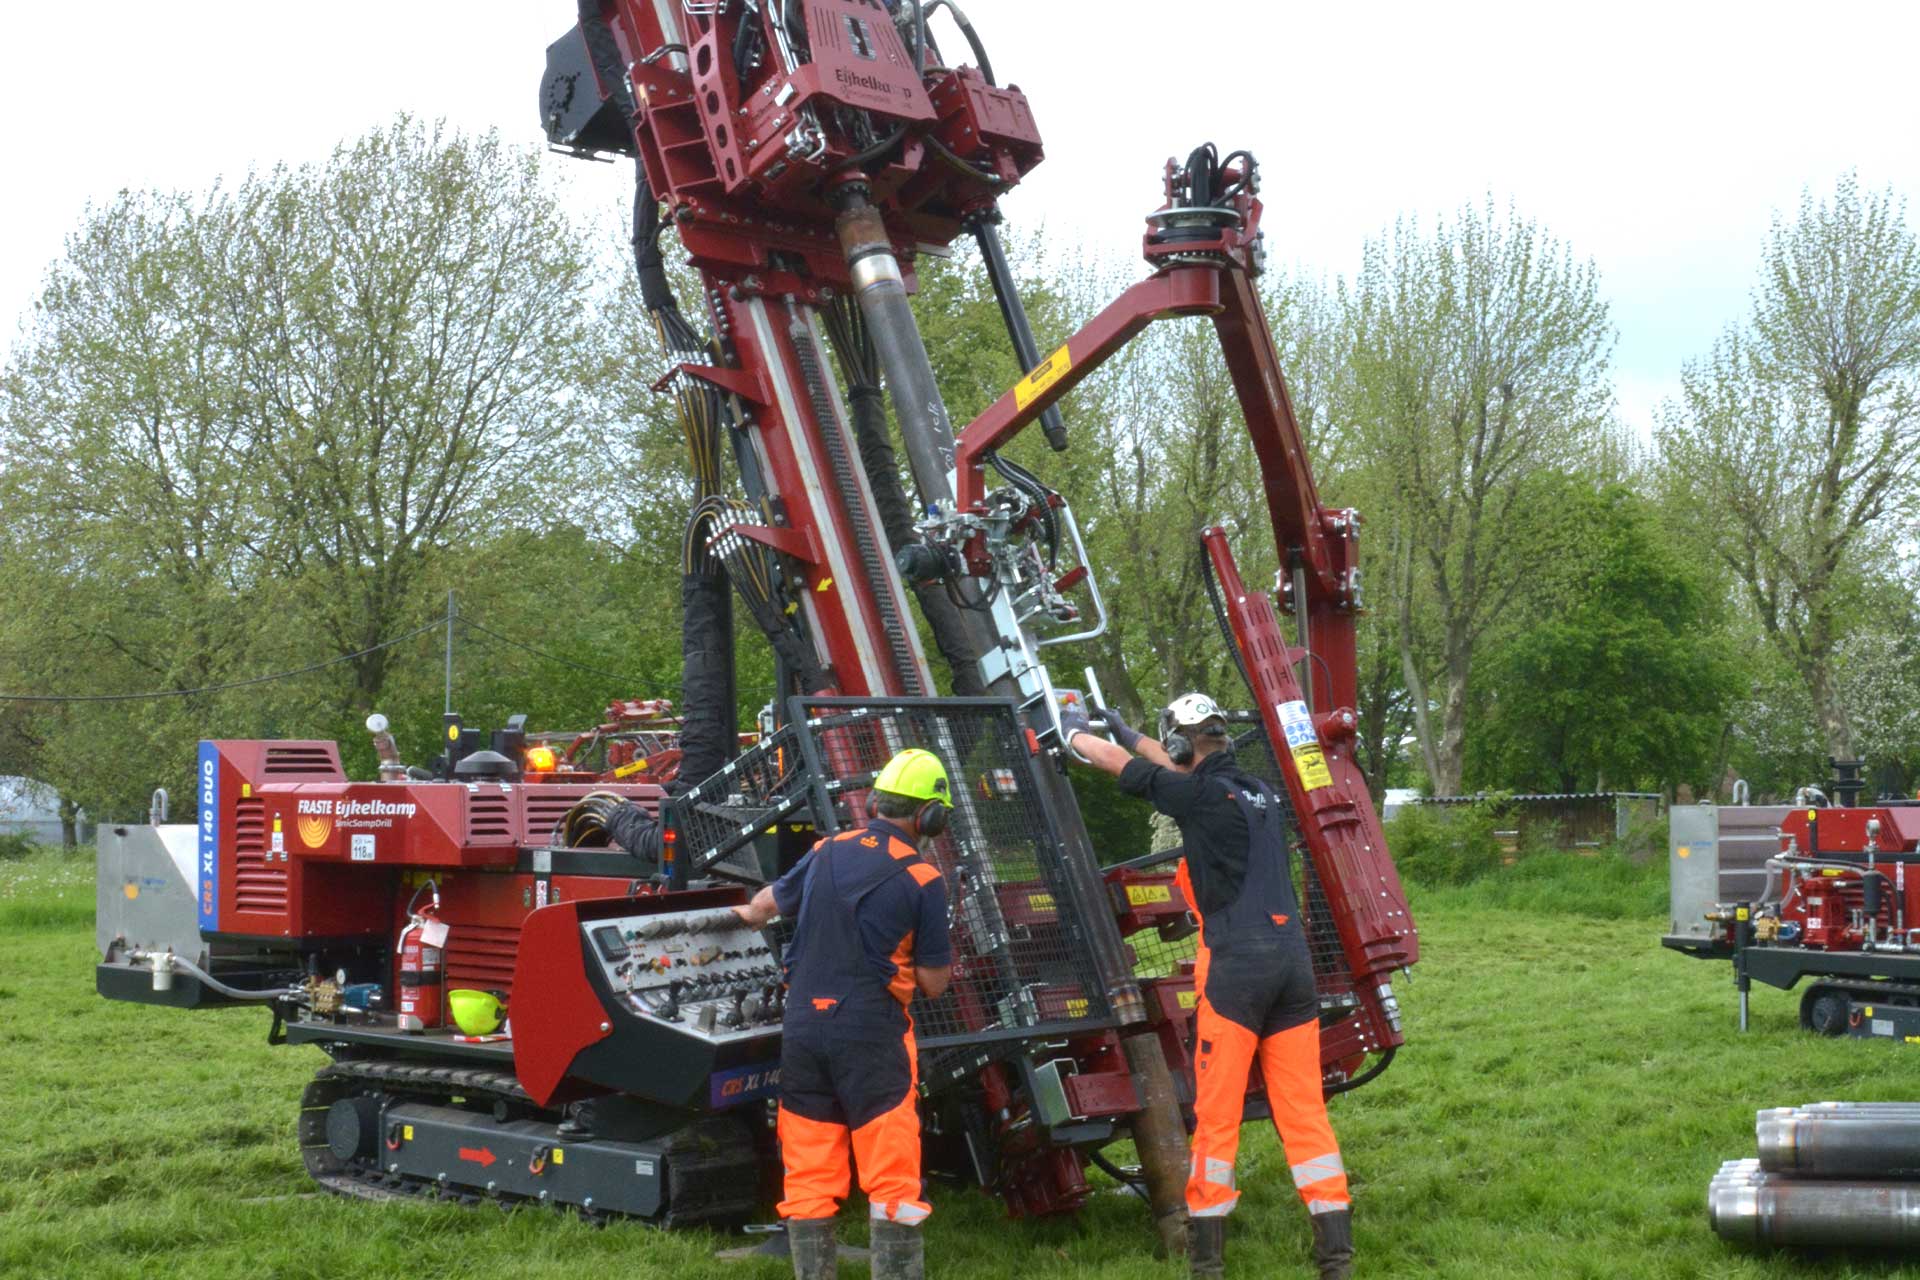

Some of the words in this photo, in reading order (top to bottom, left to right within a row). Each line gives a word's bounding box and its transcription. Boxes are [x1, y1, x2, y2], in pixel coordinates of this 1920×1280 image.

[204, 760, 213, 804] DUO
[297, 800, 333, 814] FRASTE
[335, 799, 416, 819] Eijkelkamp
[204, 810, 213, 842] 140
[204, 851, 213, 875] XL
[353, 845, 368, 858] 118
[203, 880, 213, 915] CRS
